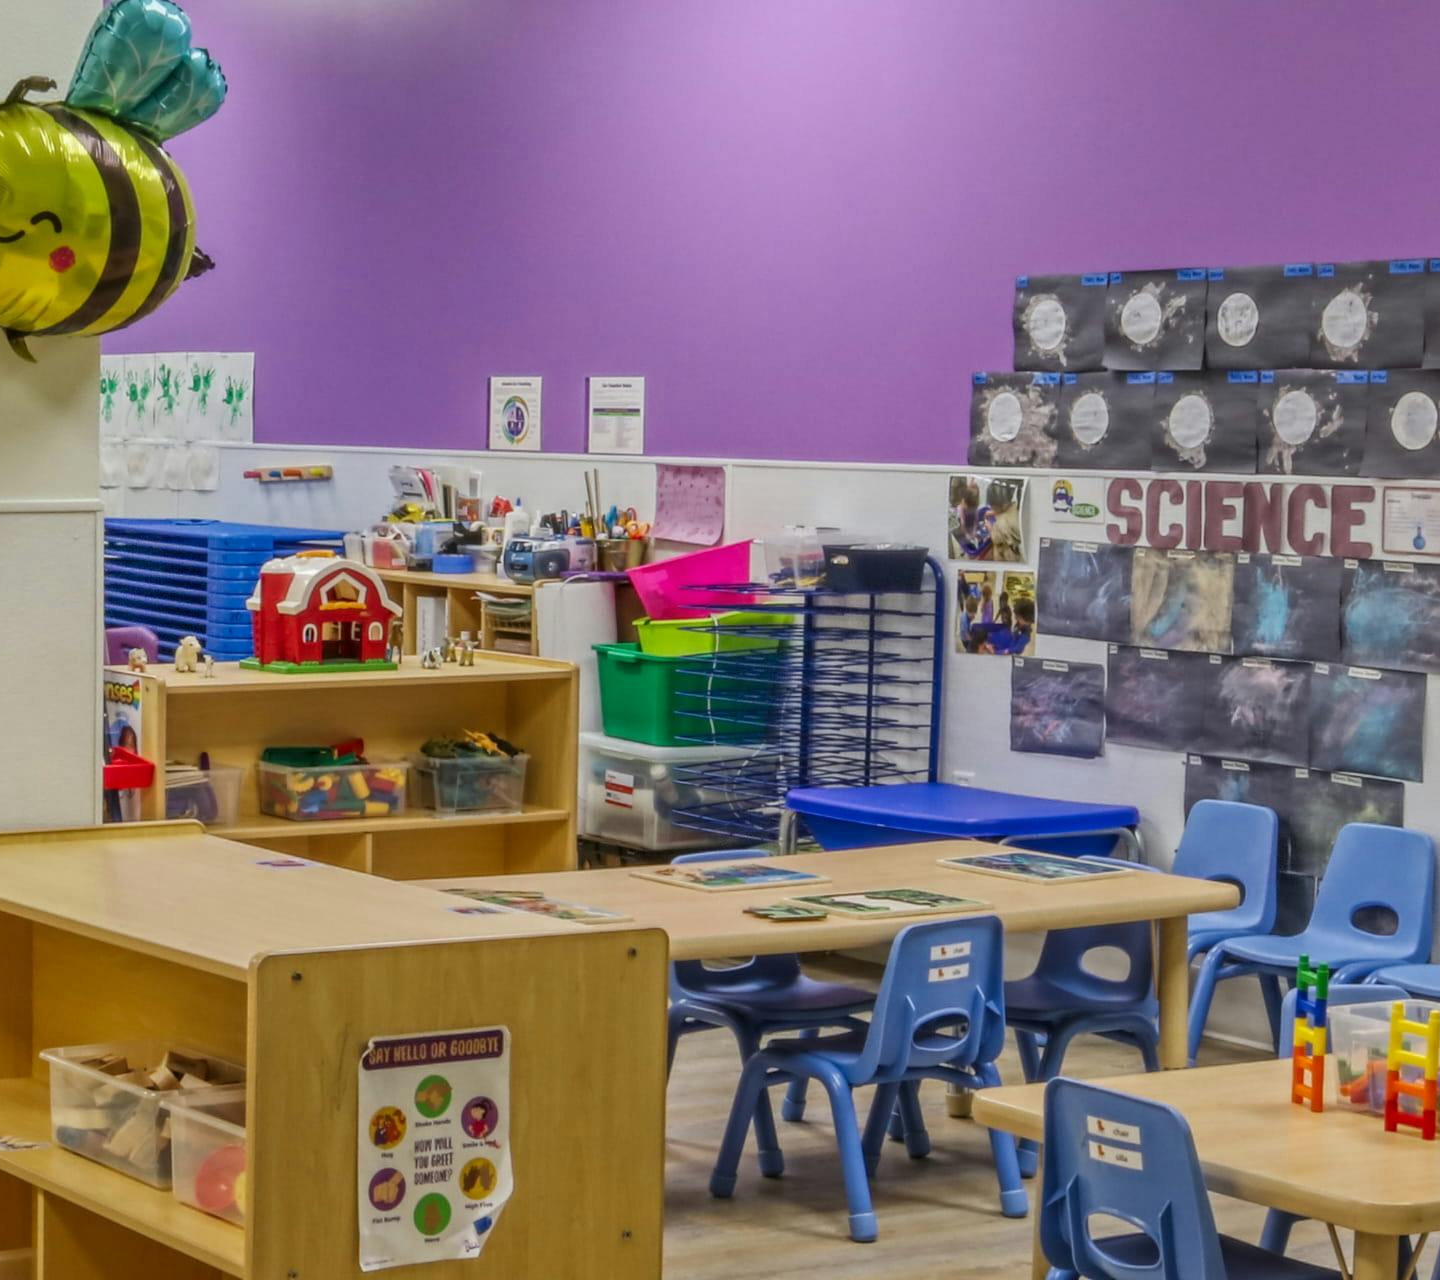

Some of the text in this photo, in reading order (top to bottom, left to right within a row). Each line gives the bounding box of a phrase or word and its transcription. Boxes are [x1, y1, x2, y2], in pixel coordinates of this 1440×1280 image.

[1105, 477, 1376, 560] SCIENCE
[368, 1036, 501, 1066] SAY HELLO OR GOODBYE
[413, 1137, 454, 1155] HOW WILL
[413, 1152, 454, 1171] YOU GREET
[413, 1169, 454, 1186] SOMEONE?
